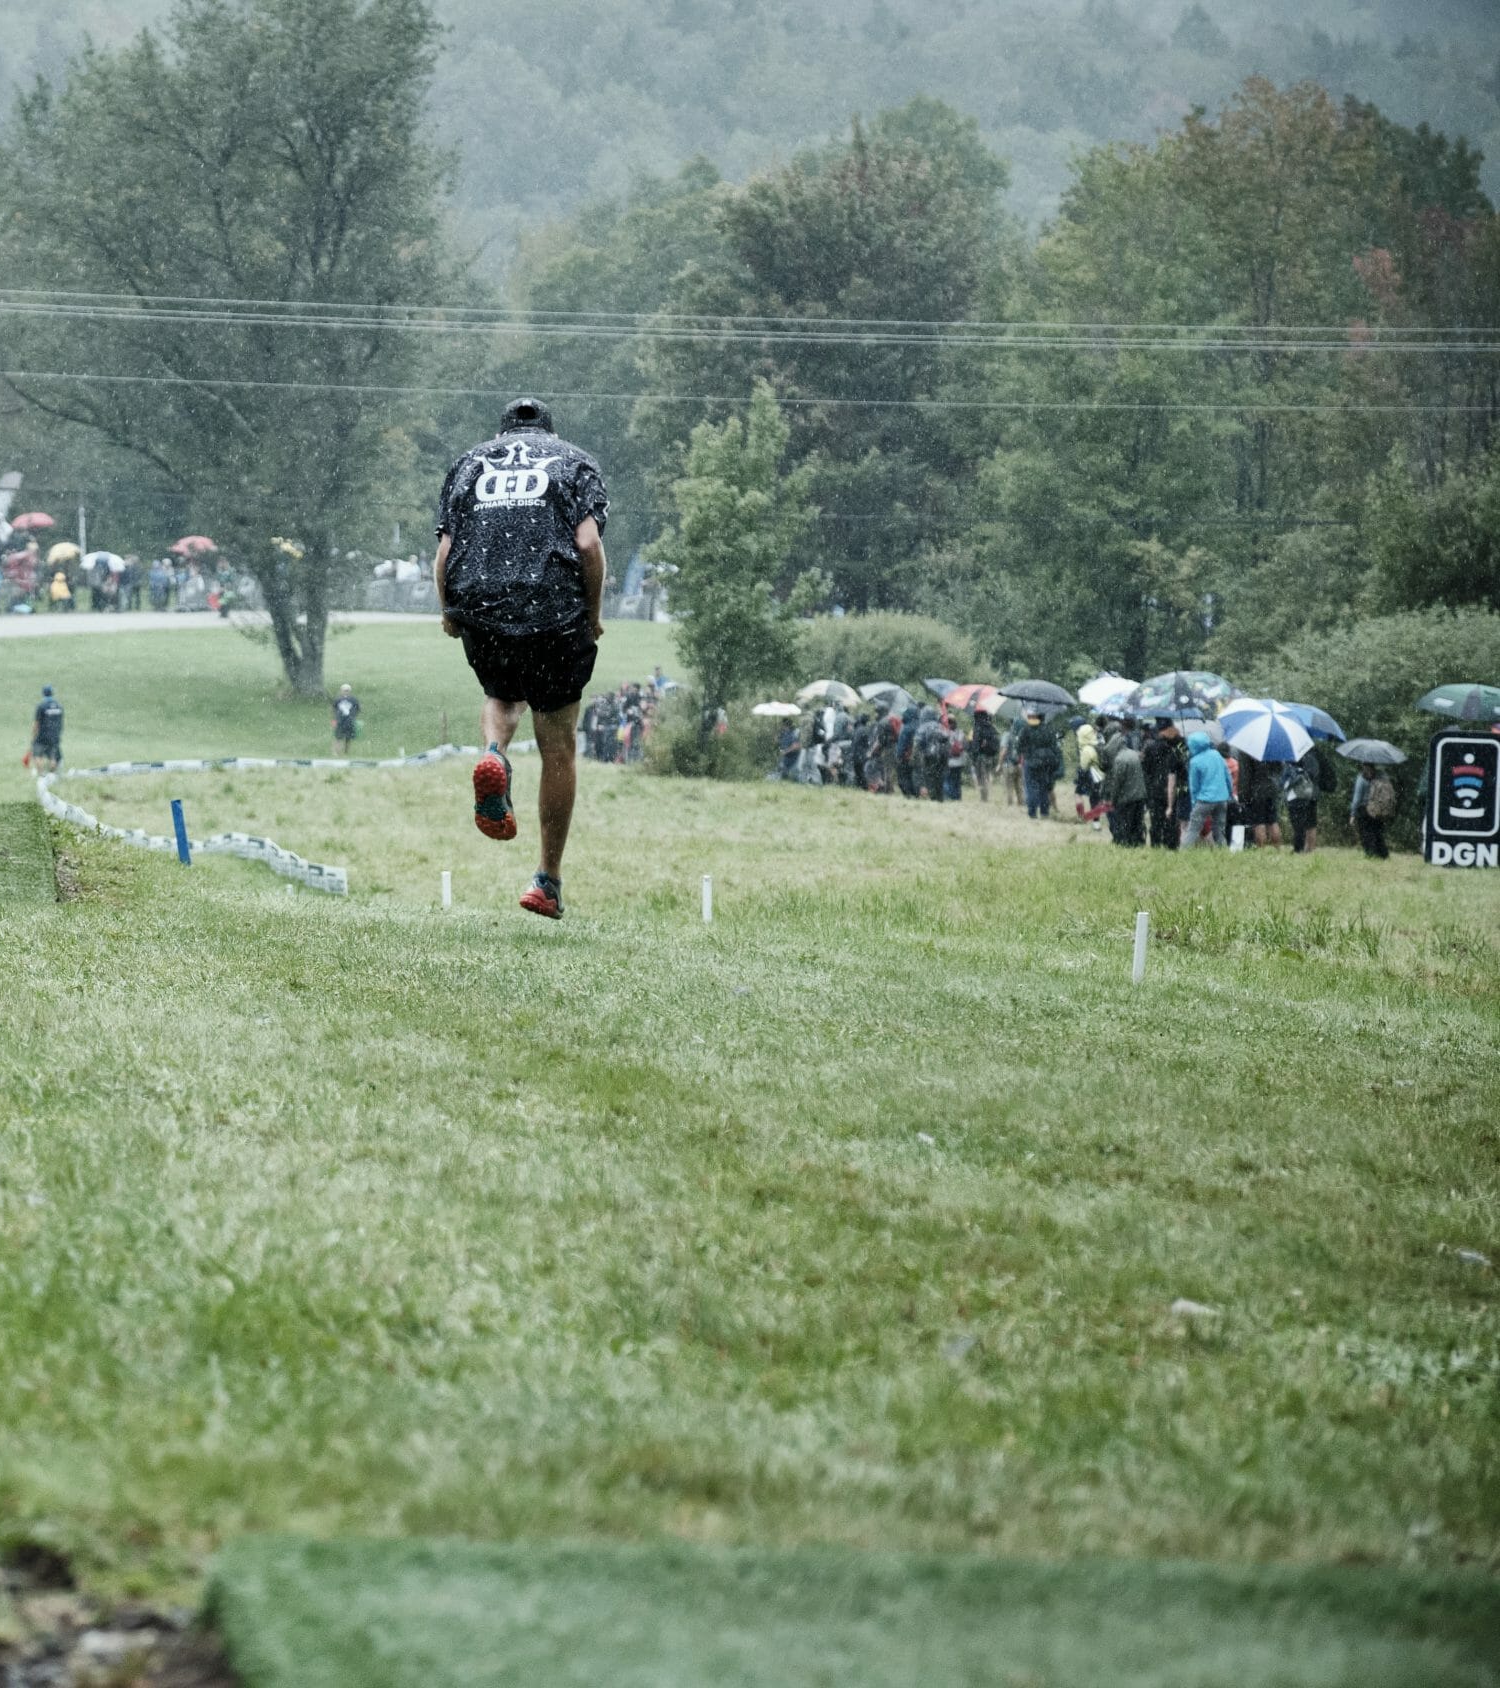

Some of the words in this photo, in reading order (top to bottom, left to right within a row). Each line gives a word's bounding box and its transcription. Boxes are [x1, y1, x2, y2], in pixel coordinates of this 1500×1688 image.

[473, 500, 516, 511] DYNAMIC
[517, 499, 547, 507] DISCS
[1431, 841, 1499, 867] DGN
